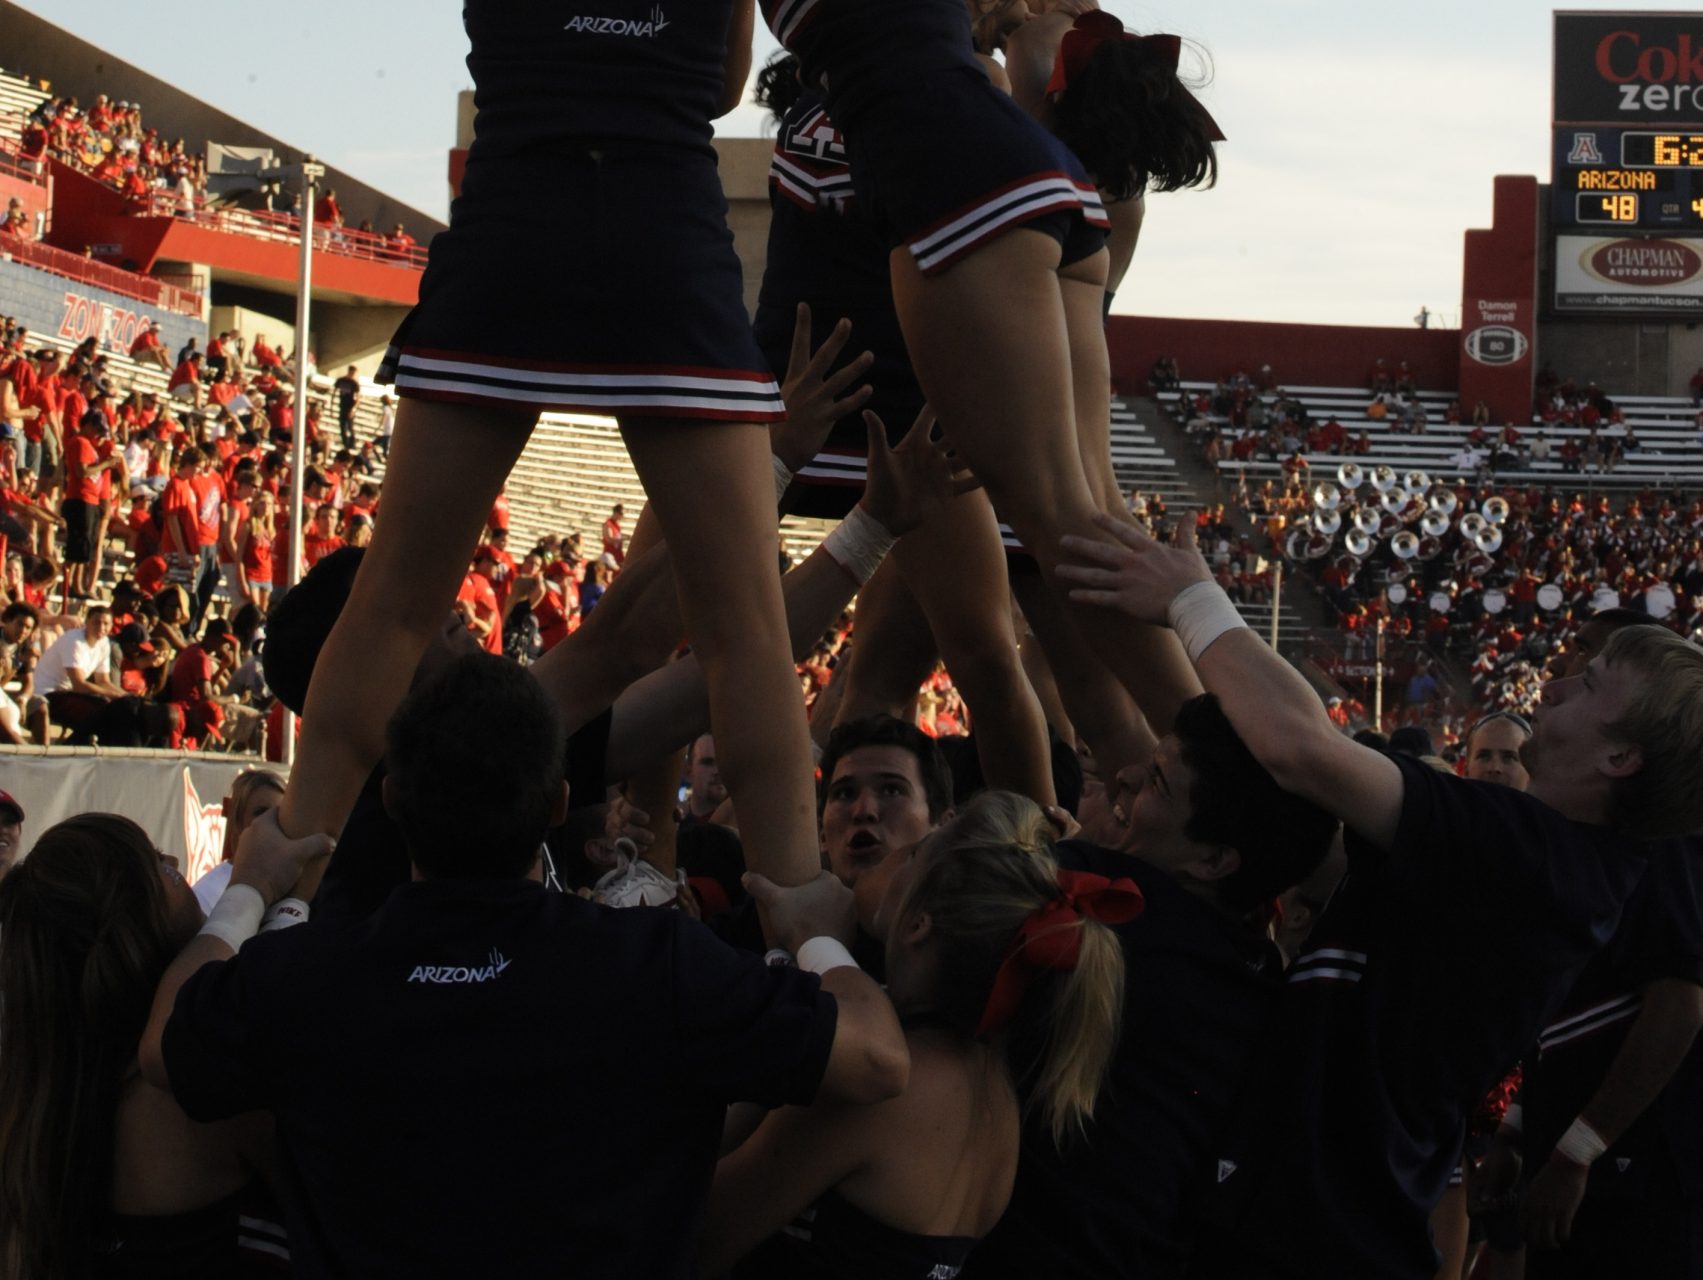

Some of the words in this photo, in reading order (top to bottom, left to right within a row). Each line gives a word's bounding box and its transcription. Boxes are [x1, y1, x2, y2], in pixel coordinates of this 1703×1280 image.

[563, 15, 654, 38] ARIZONA
[1577, 170, 1656, 190] ARIZONA
[1602, 194, 1636, 221] 48
[1607, 247, 1685, 268] CHAPMAN
[1609, 268, 1685, 278] AUTOMOTIVE
[1478, 299, 1517, 311] Damon
[1481, 310, 1516, 322] Terrell
[277, 906, 303, 918] NIKE
[407, 965, 497, 983] ARIZONA
